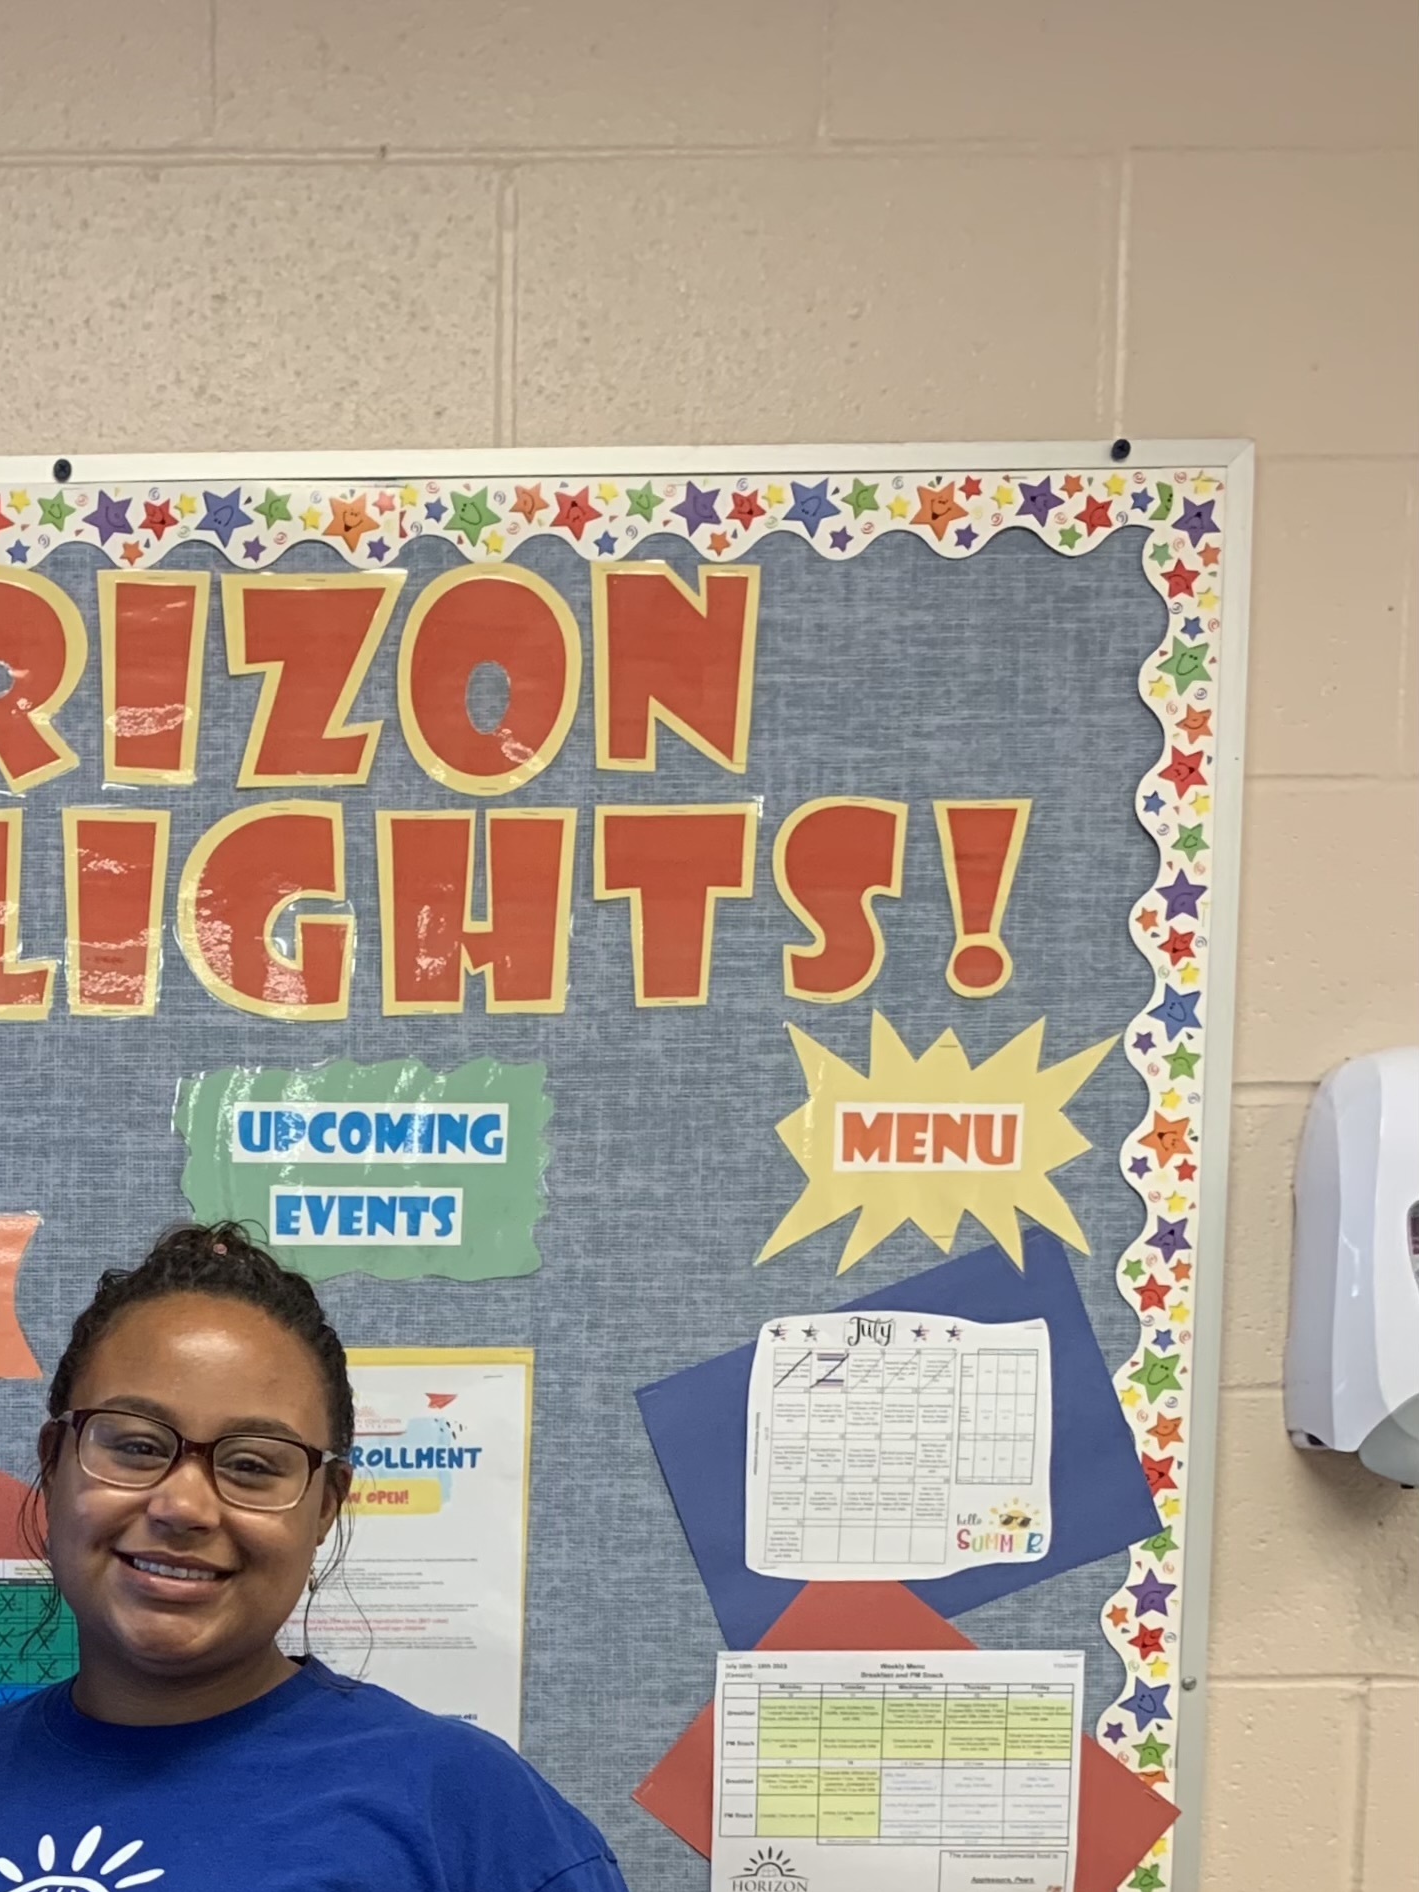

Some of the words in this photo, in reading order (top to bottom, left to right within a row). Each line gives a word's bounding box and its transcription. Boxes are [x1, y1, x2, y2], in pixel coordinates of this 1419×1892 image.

[237, 1110, 503, 1156] UPCOMING
[842, 1111, 1018, 1165] MENU
[275, 1194, 456, 1238] EVENTS
[847, 1316, 894, 1346] July
[348, 1446, 483, 1469] ROLLMENT
[366, 1489, 409, 1504] OPEN!
[957, 1528, 1043, 1554] SUMMR
[732, 1880, 808, 1892] HORIZON
